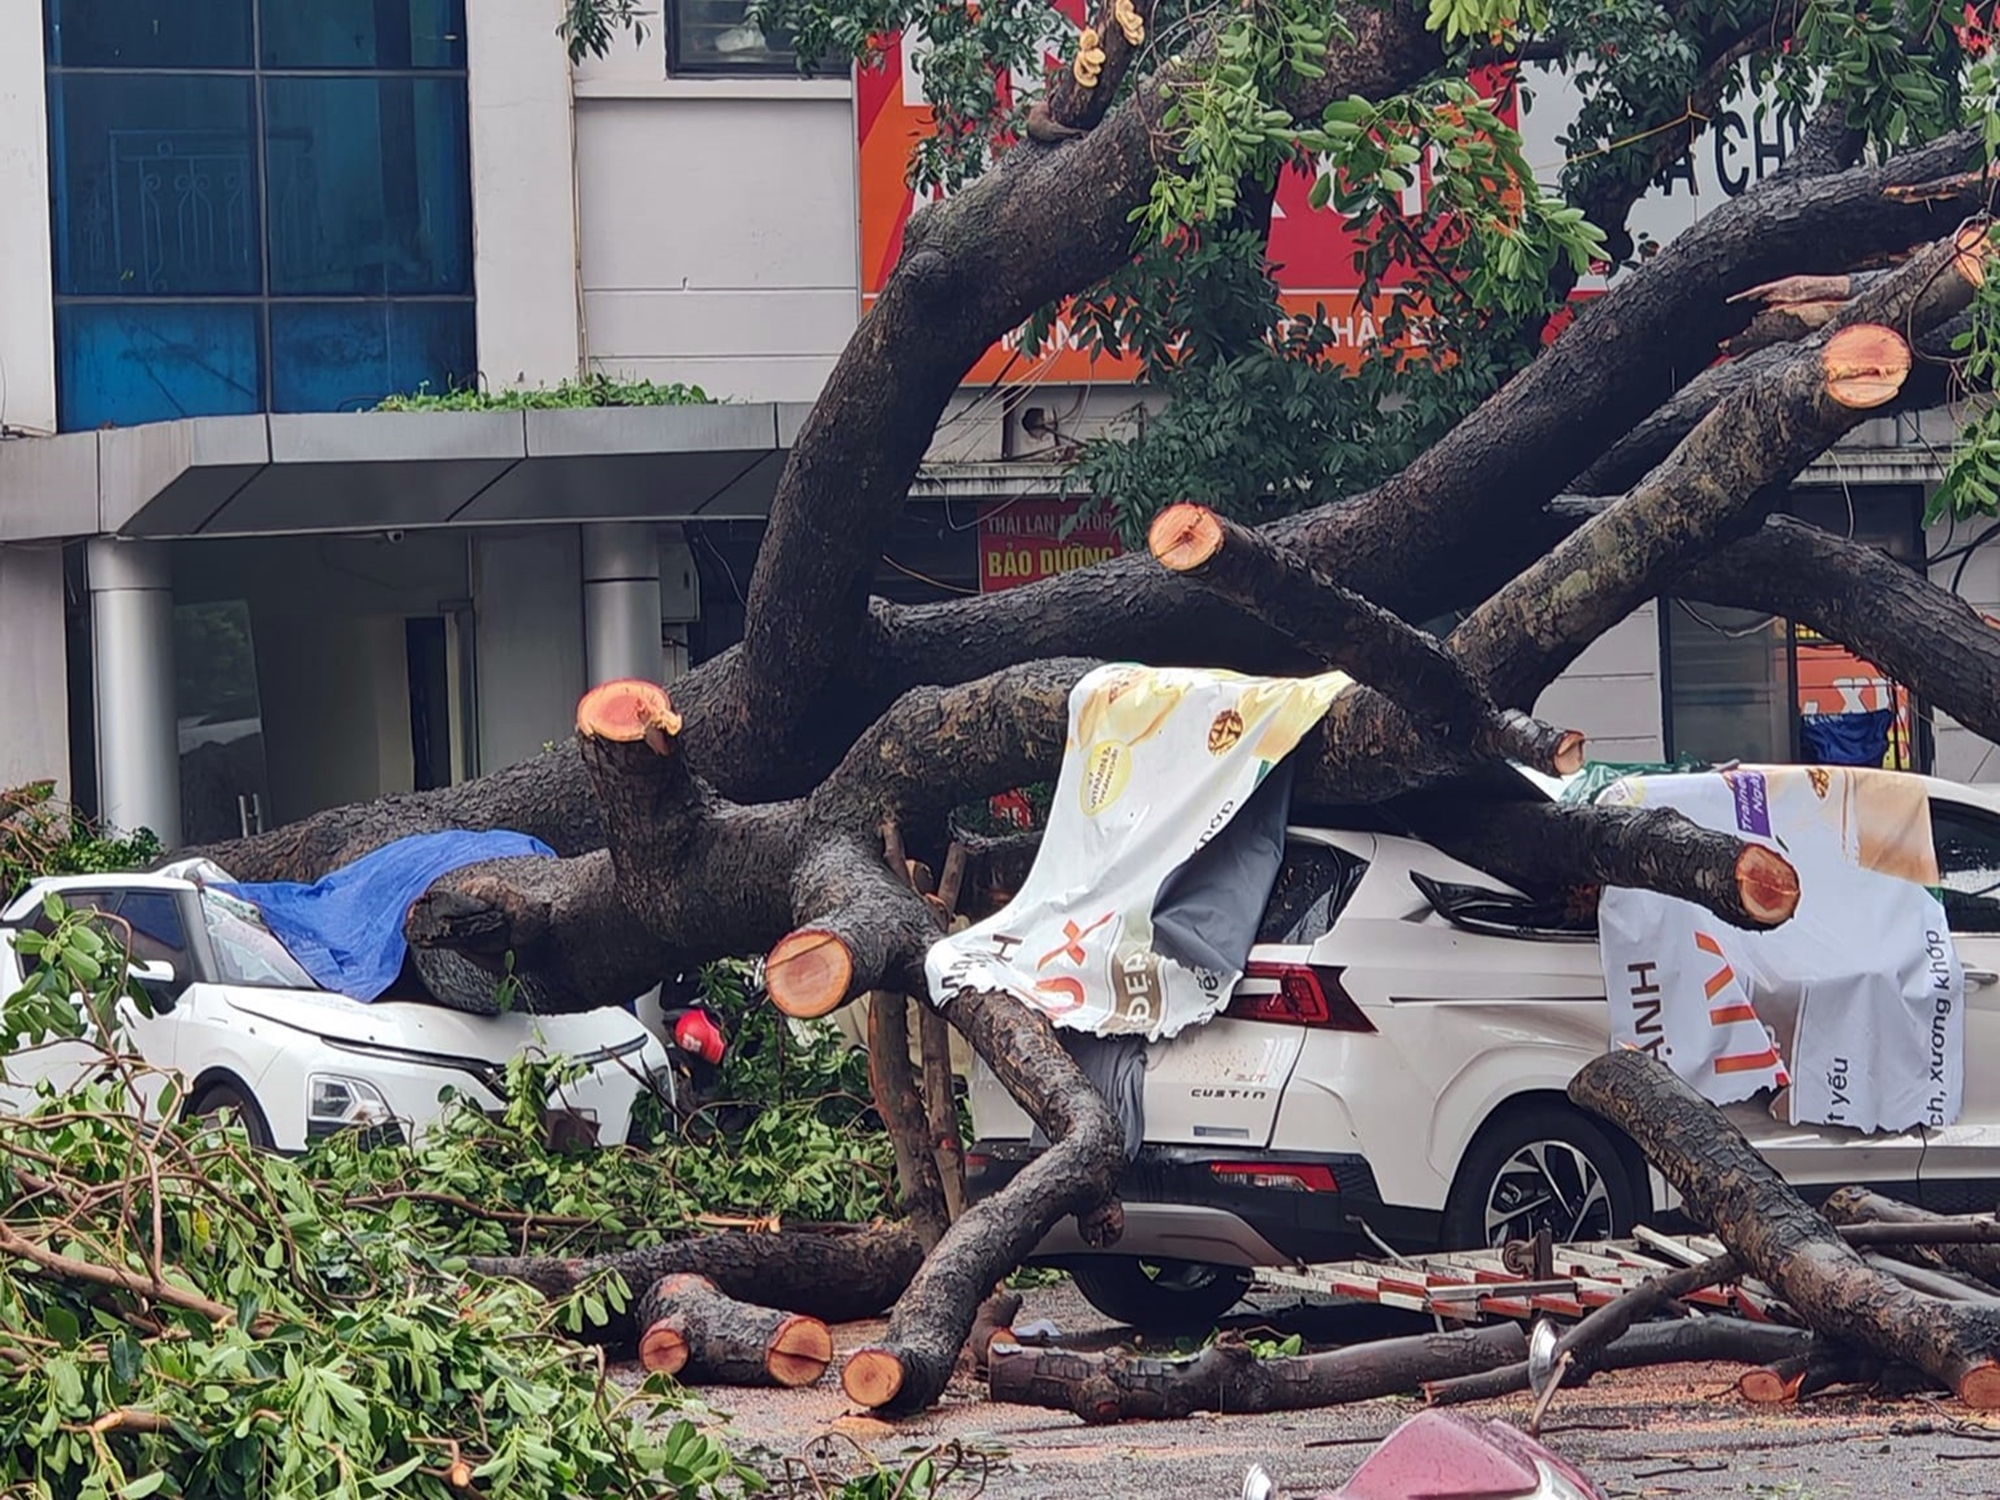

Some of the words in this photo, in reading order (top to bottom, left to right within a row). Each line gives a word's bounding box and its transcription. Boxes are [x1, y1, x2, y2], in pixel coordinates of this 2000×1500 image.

[1025, 514, 1055, 533] LAN
[987, 542, 1033, 578] BẢO
[1925, 929, 1951, 991] khớp
[1929, 998, 1952, 1084] xương
[1190, 1088, 1267, 1100] CUSTIN
[1826, 1057, 1851, 1106] yếu
